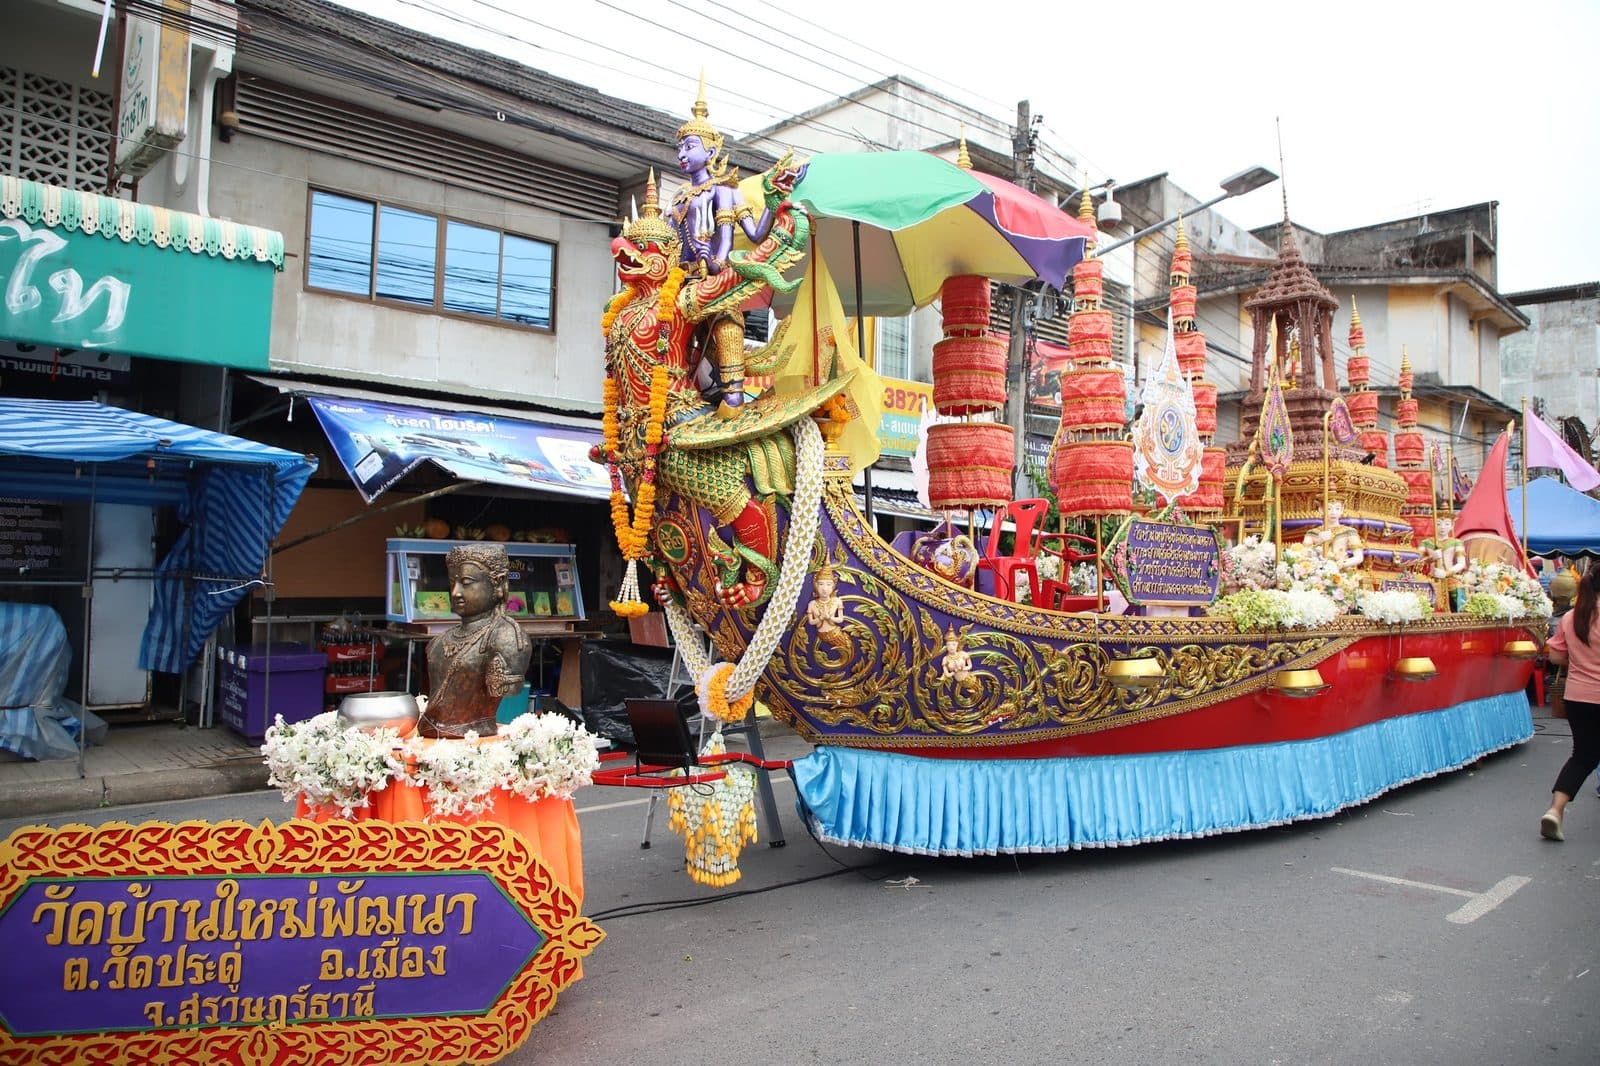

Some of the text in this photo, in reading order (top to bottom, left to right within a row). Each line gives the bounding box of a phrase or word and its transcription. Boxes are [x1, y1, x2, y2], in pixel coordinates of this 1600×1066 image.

[32, 879, 478, 946] วัดบ้านใหม่พัฒนา
[63, 937, 447, 993] ต.วัดประดู่ อ.เมือง
[143, 981, 376, 1036] จ.สุราษฎร์ธานี
